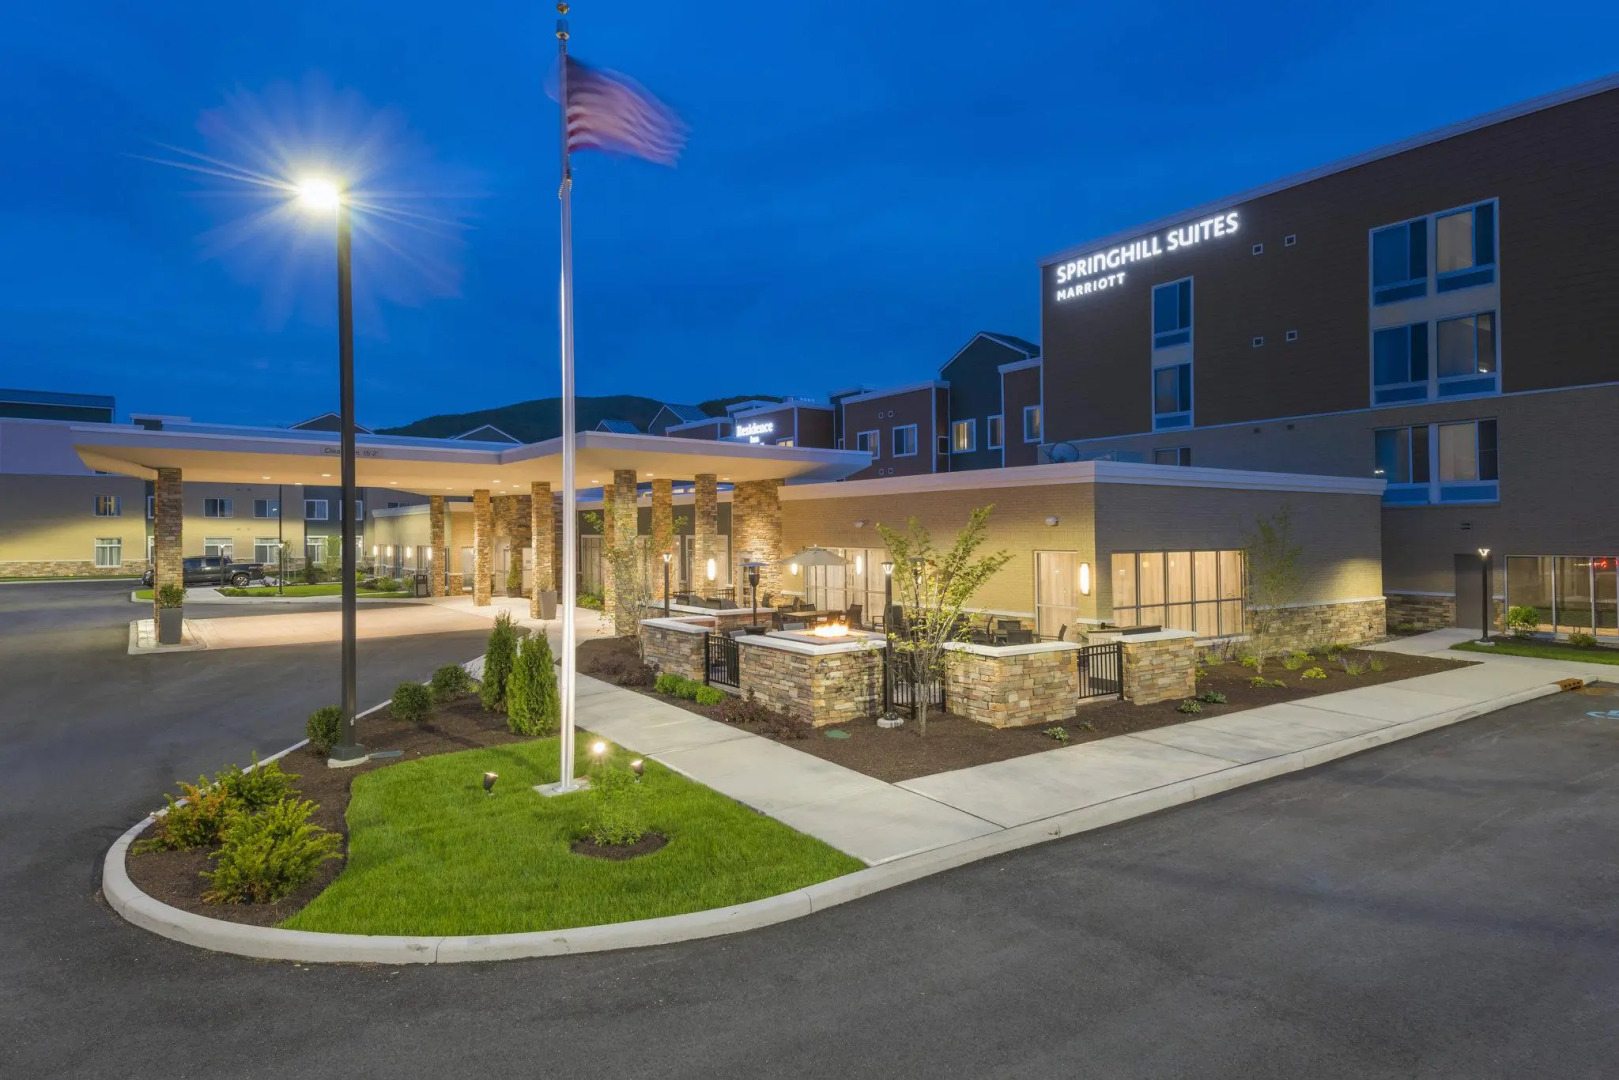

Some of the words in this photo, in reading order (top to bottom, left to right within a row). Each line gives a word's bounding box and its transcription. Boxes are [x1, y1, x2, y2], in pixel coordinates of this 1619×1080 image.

[1056, 237, 1162, 284] SPRINGHILL
[1166, 212, 1239, 251] SUITES
[1056, 271, 1126, 302] MARRIOTT
